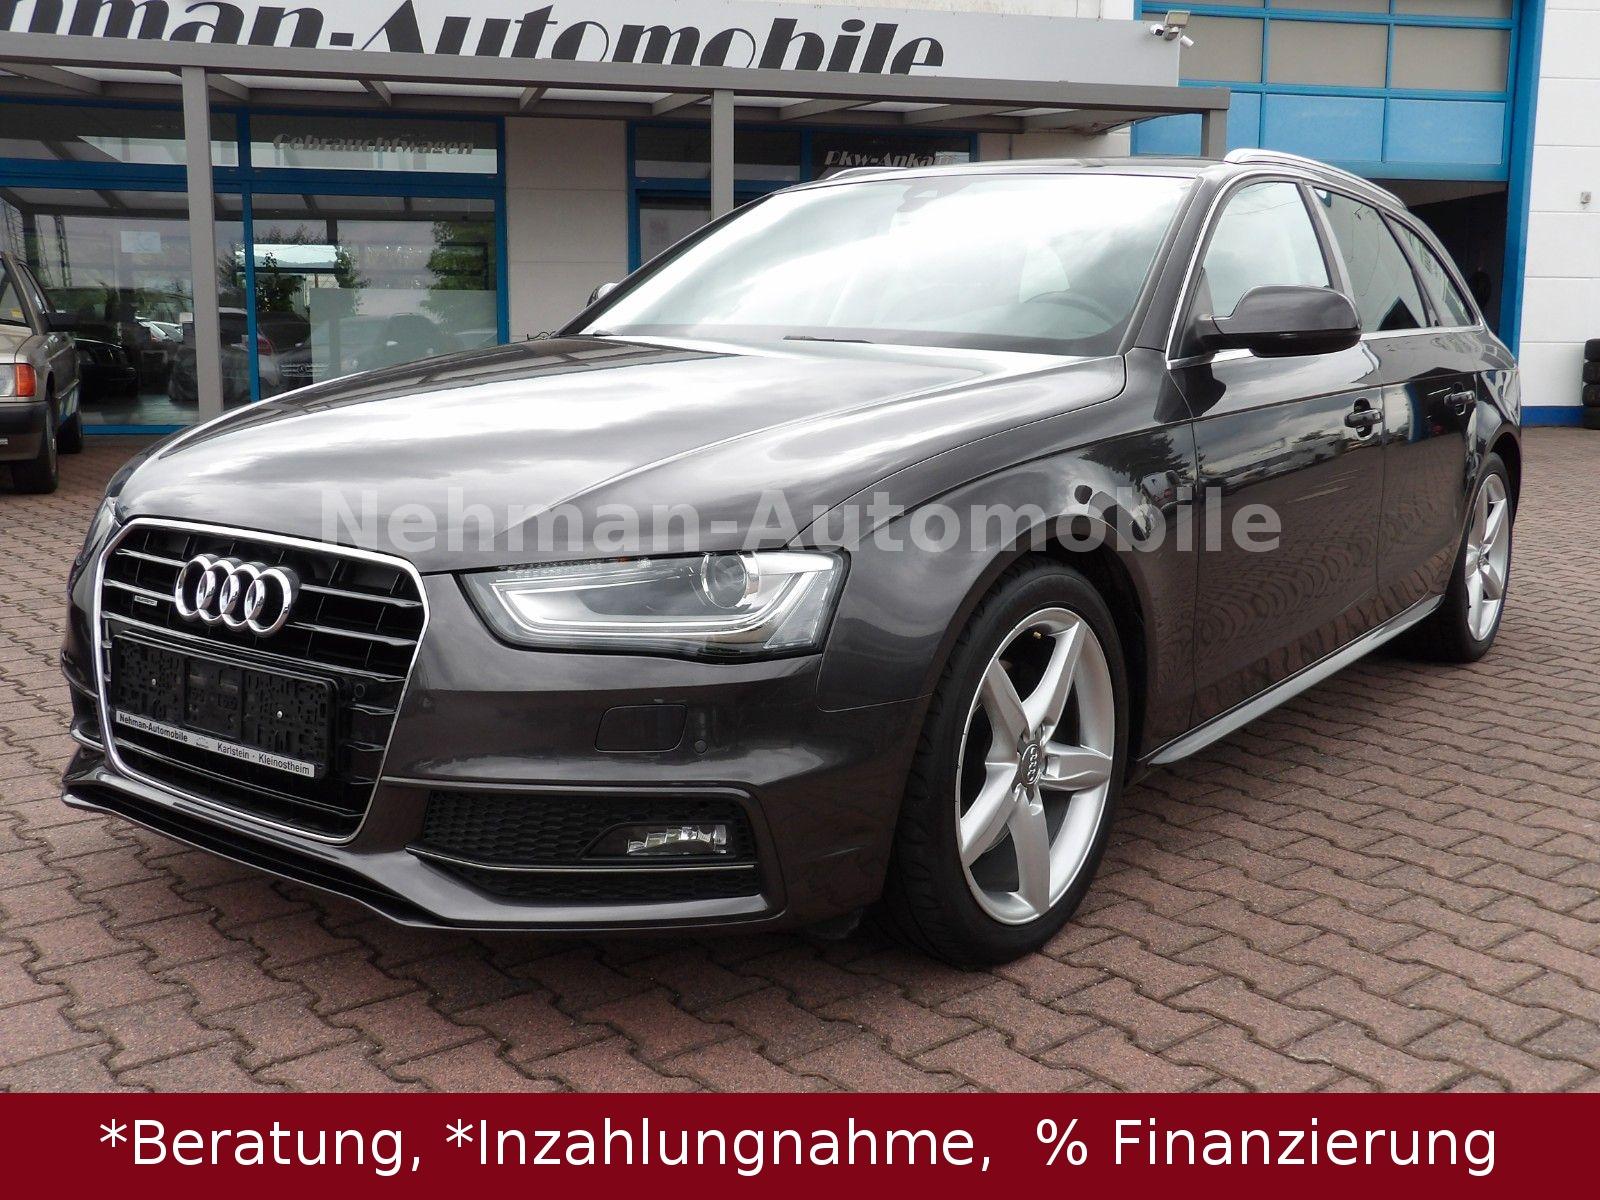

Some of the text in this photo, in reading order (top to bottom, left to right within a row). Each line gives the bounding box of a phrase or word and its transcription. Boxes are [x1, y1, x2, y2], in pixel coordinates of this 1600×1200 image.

[119, 714, 188, 742] Nehman-Automobile
[217, 742, 250, 760] Karlstein
[258, 753, 310, 775] Kleinostheim
